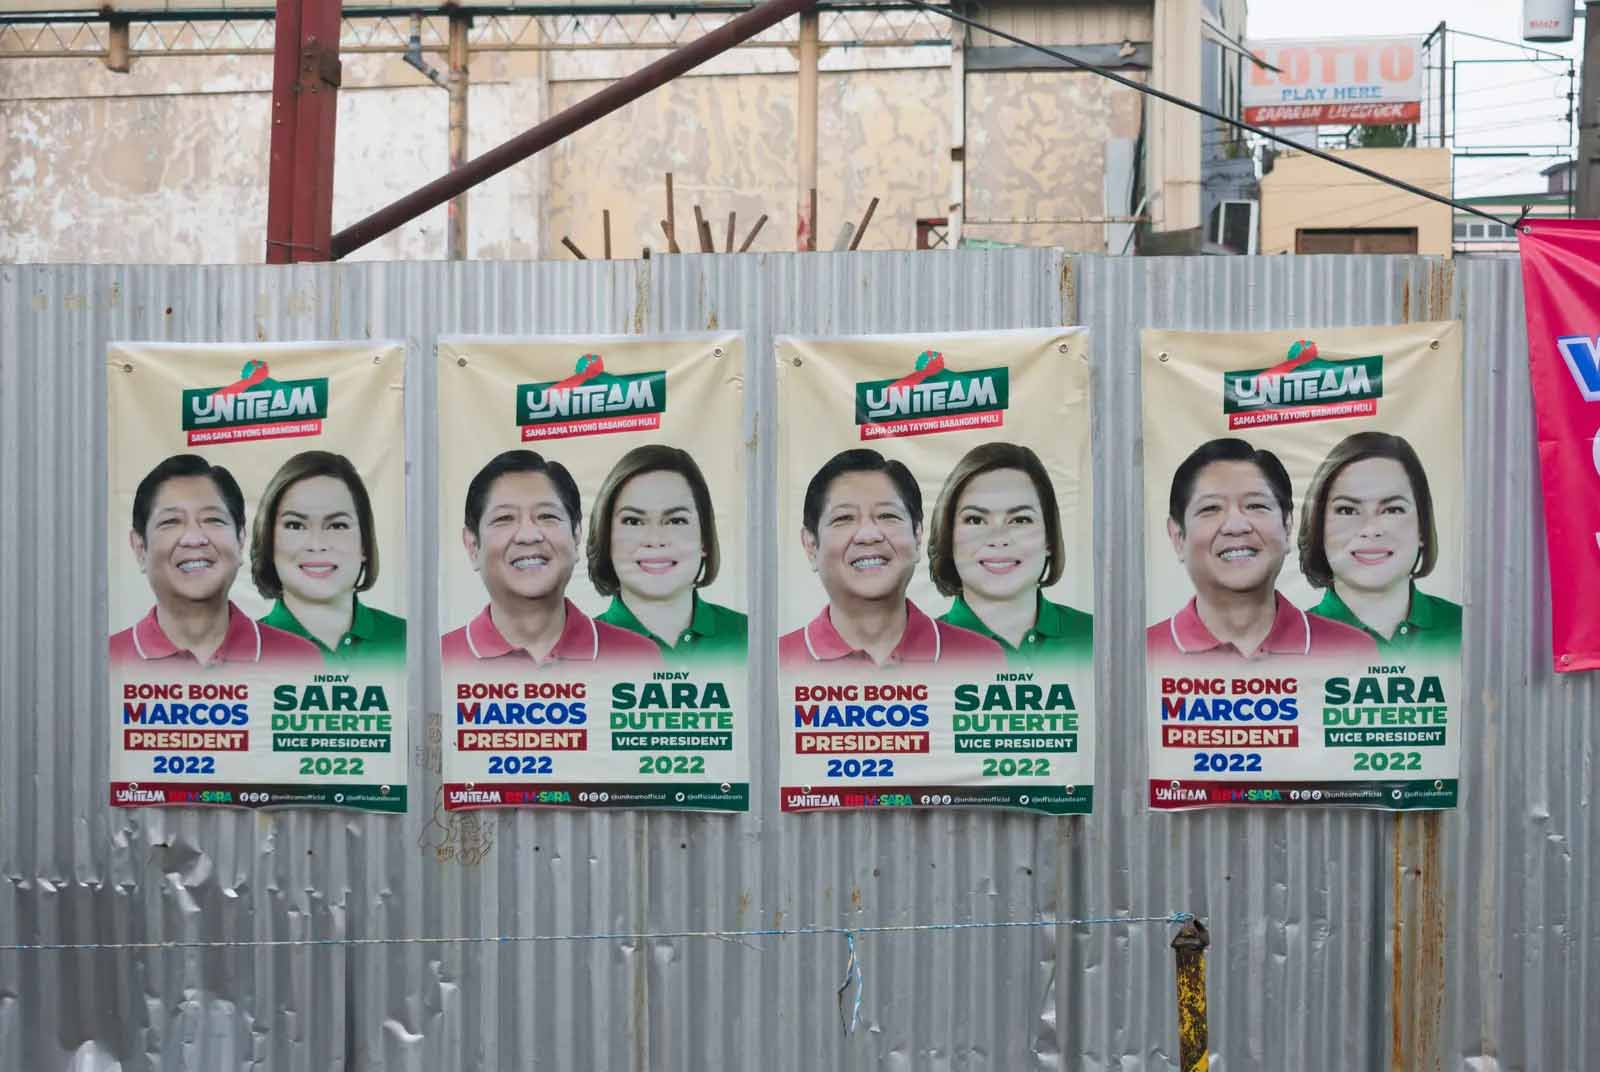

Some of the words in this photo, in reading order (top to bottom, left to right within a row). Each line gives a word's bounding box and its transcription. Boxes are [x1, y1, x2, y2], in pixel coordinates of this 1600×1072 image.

[1252, 46, 1413, 85] LOTTO
[1282, 88, 1326, 100] PLAY
[1333, 86, 1383, 99] HERE
[569, 424, 598, 433] TAYONG
[909, 422, 939, 432] TAYONG
[314, 674, 350, 683] INDAY
[653, 672, 689, 680] INDAY
[996, 673, 1034, 681] INDAY
[1368, 666, 1406, 674] INDAY
[123, 684, 183, 700] BONG
[188, 684, 248, 700] BONG
[457, 683, 518, 699] BONG
[524, 683, 586, 699] BONG
[795, 686, 858, 701] BONG
[864, 684, 928, 701] BONG
[1161, 678, 1225, 695] BONG
[1232, 678, 1297, 695] BONG
[1324, 677, 1446, 705] SARA
[273, 685, 389, 712] SARA
[612, 683, 730, 709] SARA
[954, 684, 1075, 711] SARA
[123, 703, 249, 725] MARCOS
[457, 702, 587, 725] MARCOS
[795, 704, 928, 728] MARCOS
[1161, 698, 1298, 721] MARCOS
[1322, 706, 1448, 725] DUTERTE
[271, 714, 392, 732] DUTERTE
[610, 712, 733, 729] DUTERTE
[953, 714, 1079, 732] DUTERTE
[129, 732, 244, 748] PRESIDENT
[277, 738, 308, 748] VICE
[311, 738, 386, 748] PRESIDENT
[463, 732, 582, 748] PRESIDENT
[616, 737, 648, 746] VICE
[651, 736, 728, 746] PRESIDENT
[801, 735, 924, 751] PRESIDENT
[959, 739, 991, 748] VICE
[995, 738, 1073, 748] PRESIDENT
[1168, 728, 1293, 745] PRESIDENT
[1329, 732, 1362, 742] VICE
[1366, 731, 1442, 742] PRESIDENT
[153, 756, 215, 774] 2022
[299, 757, 364, 775] 2022
[488, 756, 552, 774] 2022
[639, 756, 705, 774] 2022
[827, 759, 894, 777] 2022
[982, 758, 1050, 777] 2022
[1193, 753, 1262, 772] 2022
[1353, 752, 1421, 771] 2022
